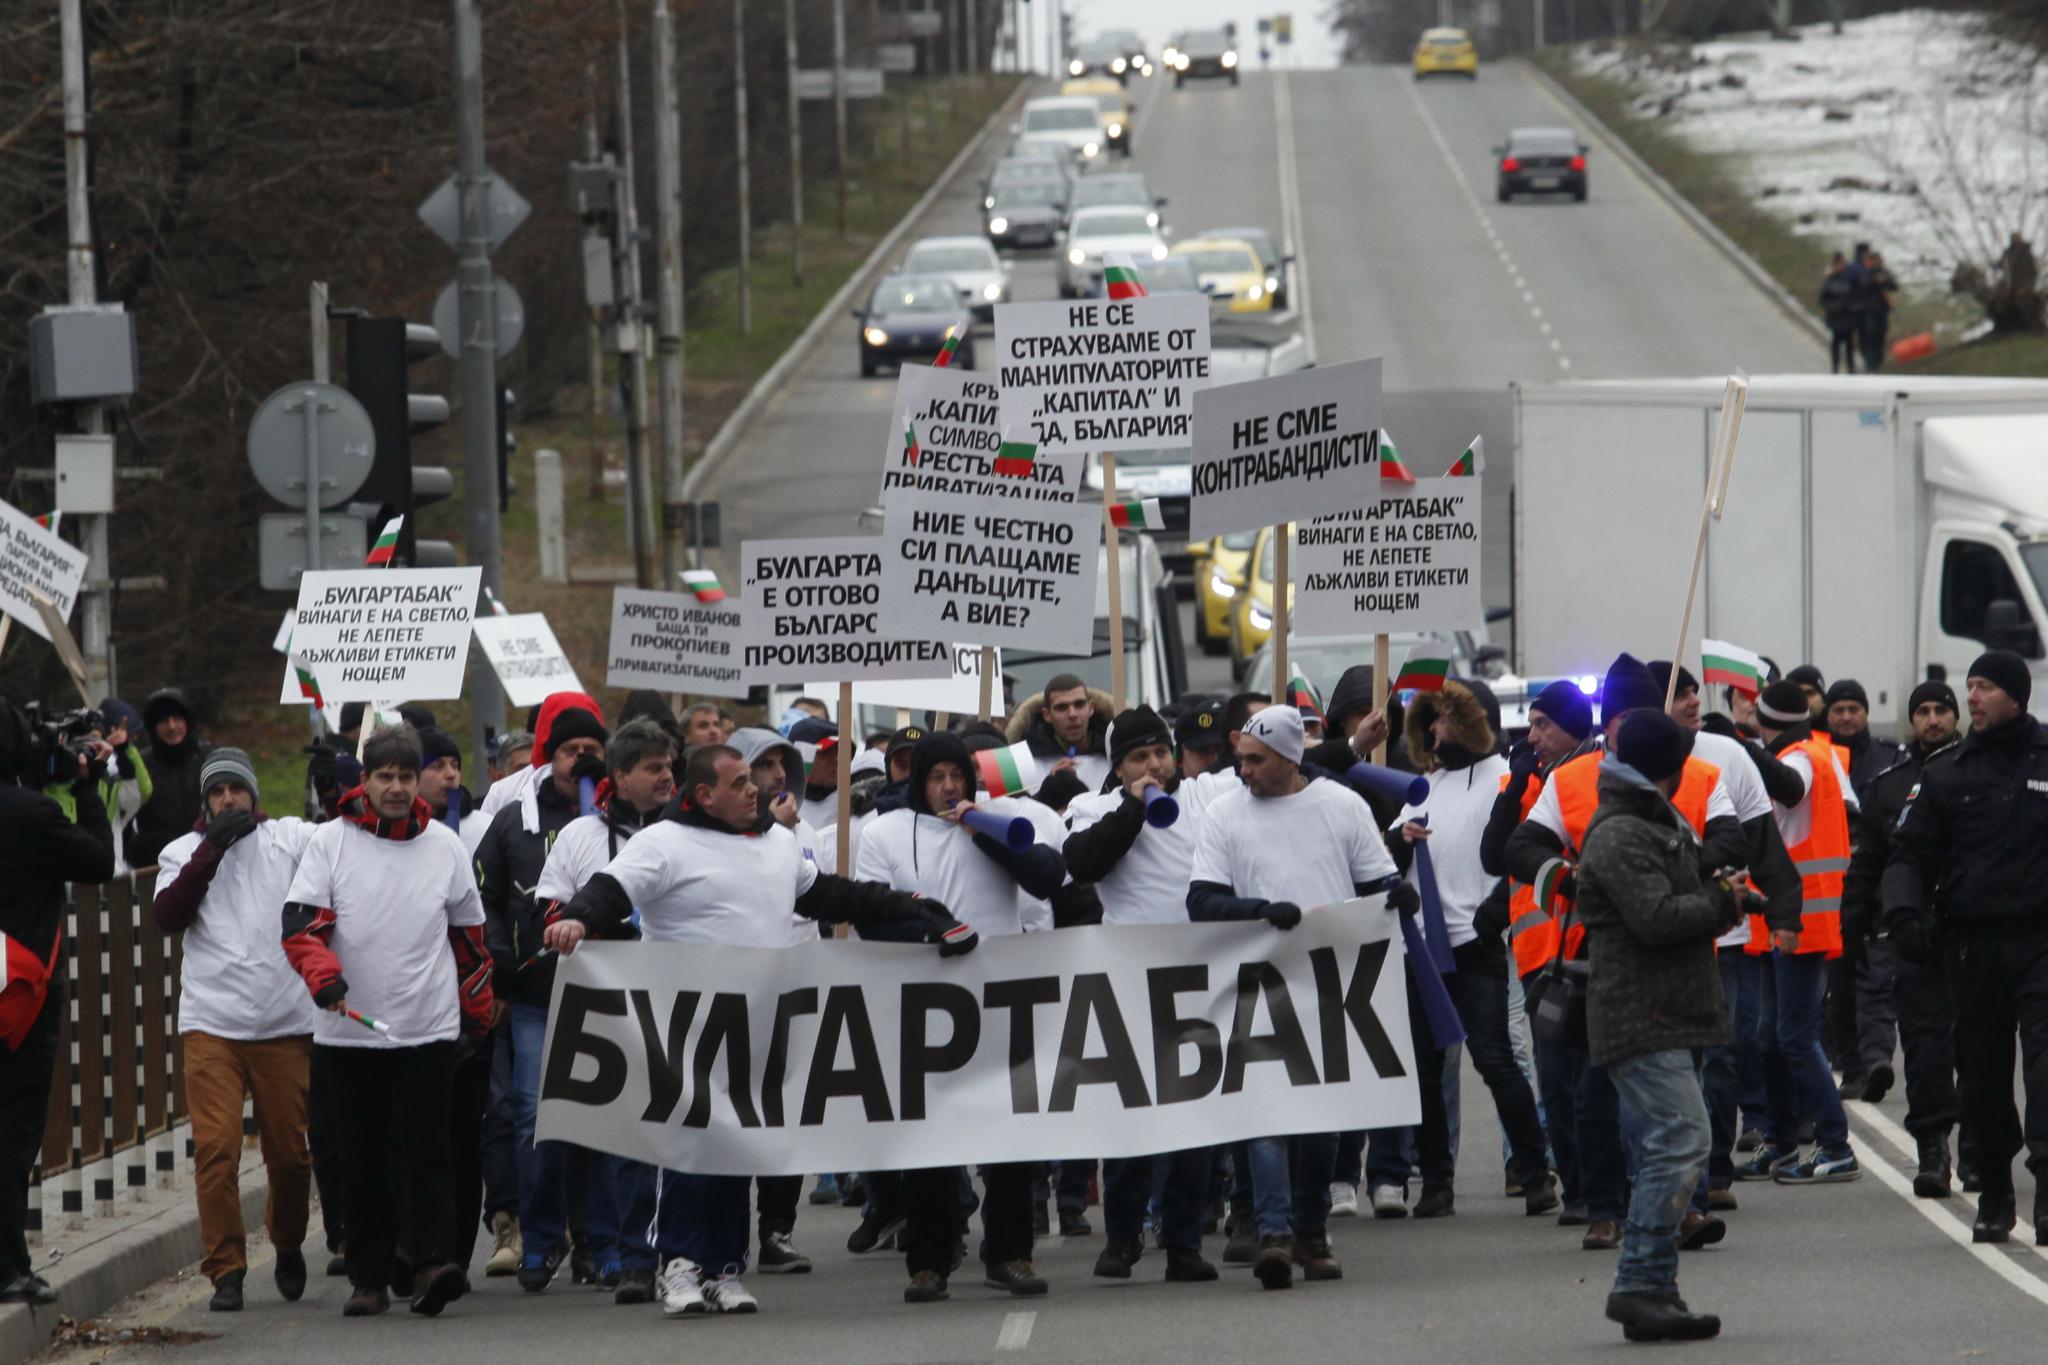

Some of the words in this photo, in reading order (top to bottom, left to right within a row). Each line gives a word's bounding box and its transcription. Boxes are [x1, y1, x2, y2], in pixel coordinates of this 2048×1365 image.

[1069, 306, 1098, 327] НЕ
[1106, 304, 1134, 326] СЕ
[1011, 331, 1160, 359] СТРАХУВАМЕ
[1167, 329, 1196, 351] ОТ
[1001, 357, 1209, 388] МАНИПУЛАТОРИТЕ
[1164, 387, 1181, 407] И
[915, 399, 999, 426] „КАПИ
[1233, 416, 1269, 450] НЕ
[1277, 402, 1337, 440] СМЕ
[1192, 429, 1378, 497] КОНТРАБАНДИСТИ
[912, 511, 966, 535] НИЕ
[974, 516, 1074, 546] ЧЕСТНО
[1298, 526, 1364, 545] ВИНАГИ
[1370, 526, 1379, 543] Е
[1385, 525, 1407, 542] НА
[1413, 522, 1477, 542] СВЕТЛО,
[901, 538, 937, 562] СИ
[945, 543, 1081, 575] ПЛАЩАМЕ
[1343, 549, 1364, 566] НЕ
[1370, 547, 1432, 565] ЛЕПЕТЕ
[914, 569, 1061, 605] ДАНЪЦИТЕ,
[1305, 571, 1389, 591] ЛЪЖЛИВИ
[1395, 568, 1468, 587] ЕТИКЕТИ
[313, 584, 462, 608] „БУЛГАРТАБАК“
[763, 588, 777, 608] Е
[785, 584, 880, 607] ОТГОВО
[1354, 593, 1419, 613] НОЩЕМ
[297, 608, 362, 625] ВИНАГИ
[366, 609, 377, 623] Е
[381, 608, 403, 623] НА
[408, 607, 470, 623] СВЕТЛО,
[622, 603, 679, 621] ХРИСТО
[683, 609, 741, 627] ИВАНОВ
[941, 600, 959, 622] А
[967, 603, 1031, 628] ВИЕ?
[338, 628, 359, 643] НЕ
[363, 627, 424, 643] ЛЕПЕТЕ
[656, 622, 690, 637] БАЩА
[693, 625, 708, 637] ТИ
[385, 646, 456, 662] ЕТИКЕТИ
[631, 633, 730, 656] ПРОКОПИЕВ
[744, 640, 948, 667] ПРОИЗВОДИТЕЛ
[342, 666, 406, 684] НОЩЕМ
[540, 939, 1406, 1128] БУЛГАРТАБАК
